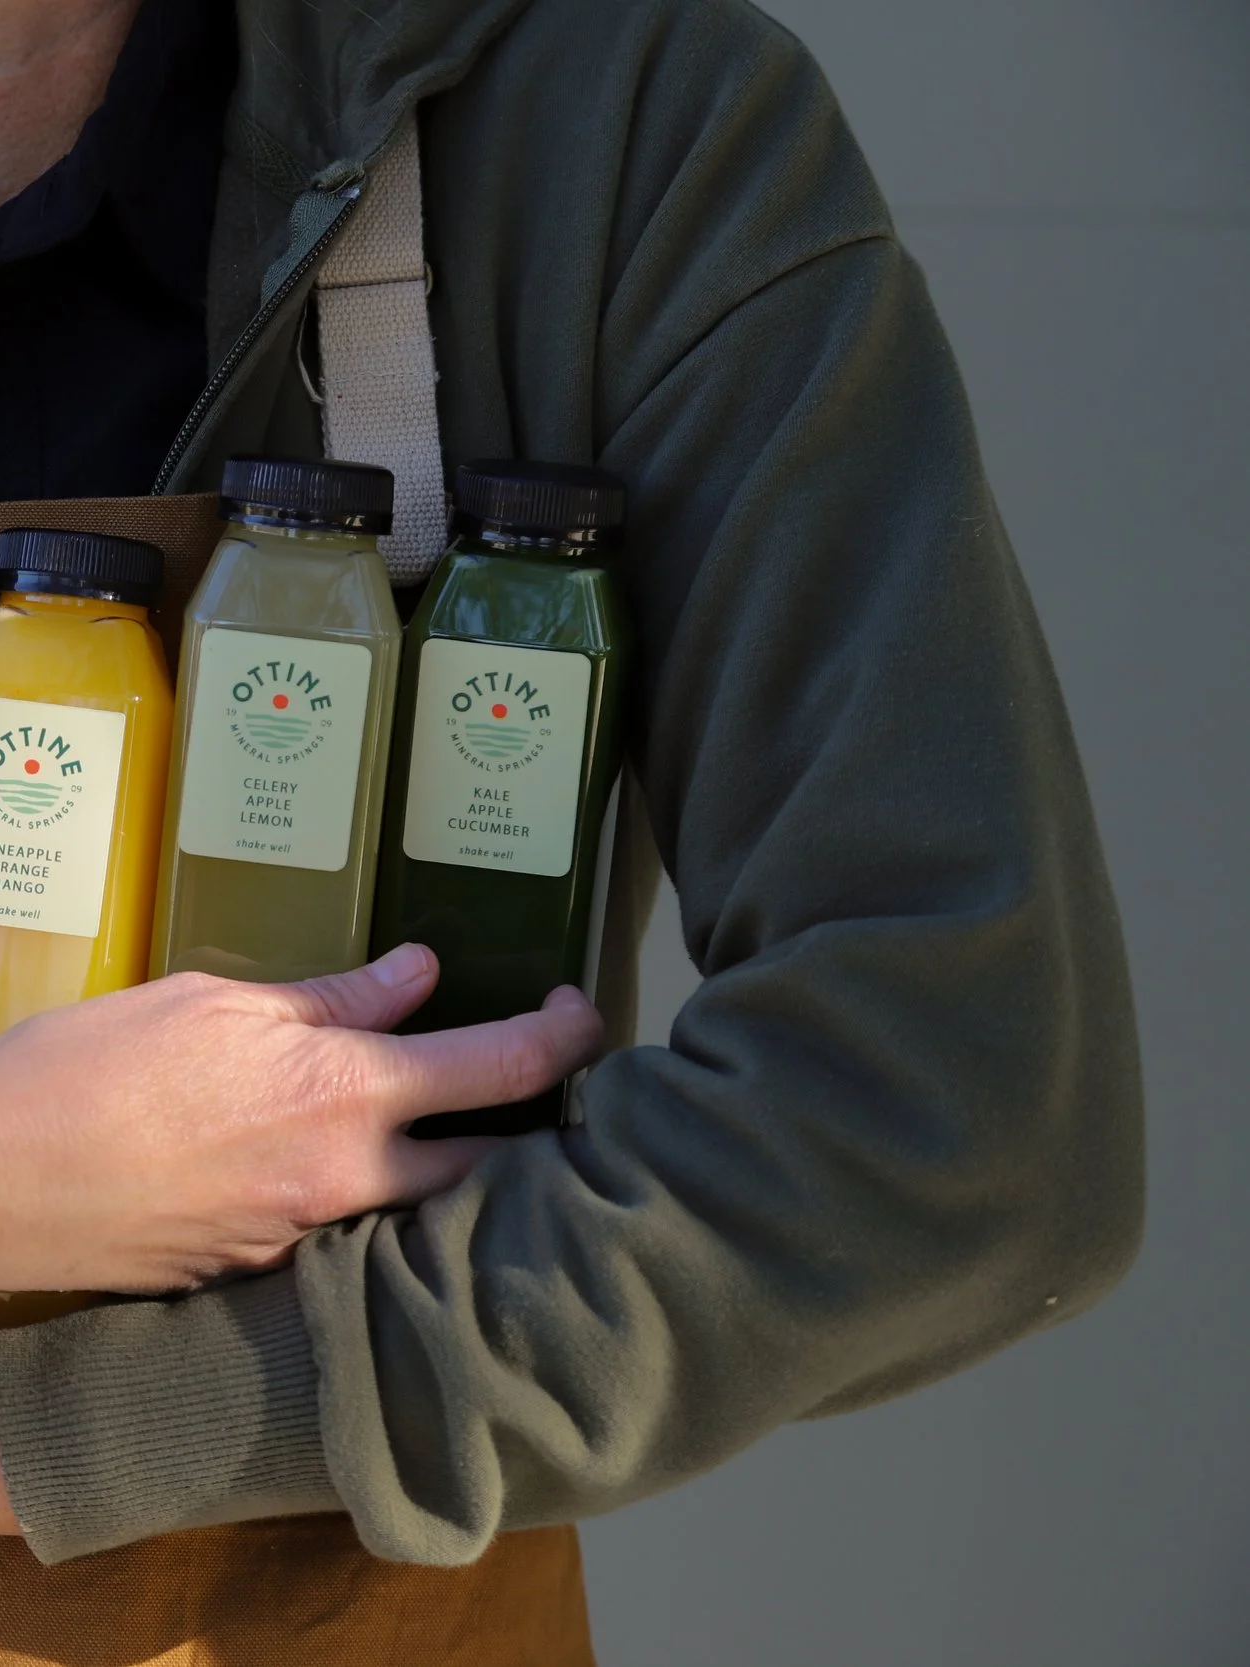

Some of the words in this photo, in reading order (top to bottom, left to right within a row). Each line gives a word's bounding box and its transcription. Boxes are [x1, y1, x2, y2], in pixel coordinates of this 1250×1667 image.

[233, 661, 331, 711] OTTINE
[452, 672, 550, 721] OTTINE
[227, 708, 237, 716] 19
[321, 719, 332, 728] 09
[447, 718, 456, 726] 19
[230, 724, 270, 763] MINERAL
[277, 735, 324, 764] SPRINGS
[451, 733, 491, 771] MINERAL
[498, 743, 543, 772] SPRINGS
[71, 785, 82, 793] 09
[244, 778, 298, 794] CELERY
[474, 787, 510, 802] KALE
[246, 795, 291, 811] APPLE
[468, 803, 513, 819] APPLE
[28, 800, 74, 829] SPRINGS
[240, 812, 293, 828] LEMON
[448, 818, 529, 837] CUCUMBER
[236, 839, 266, 850] shake
[270, 842, 290, 853] well
[459, 846, 489, 857] shake
[493, 849, 513, 860] well
[20, 908, 40, 919] well
